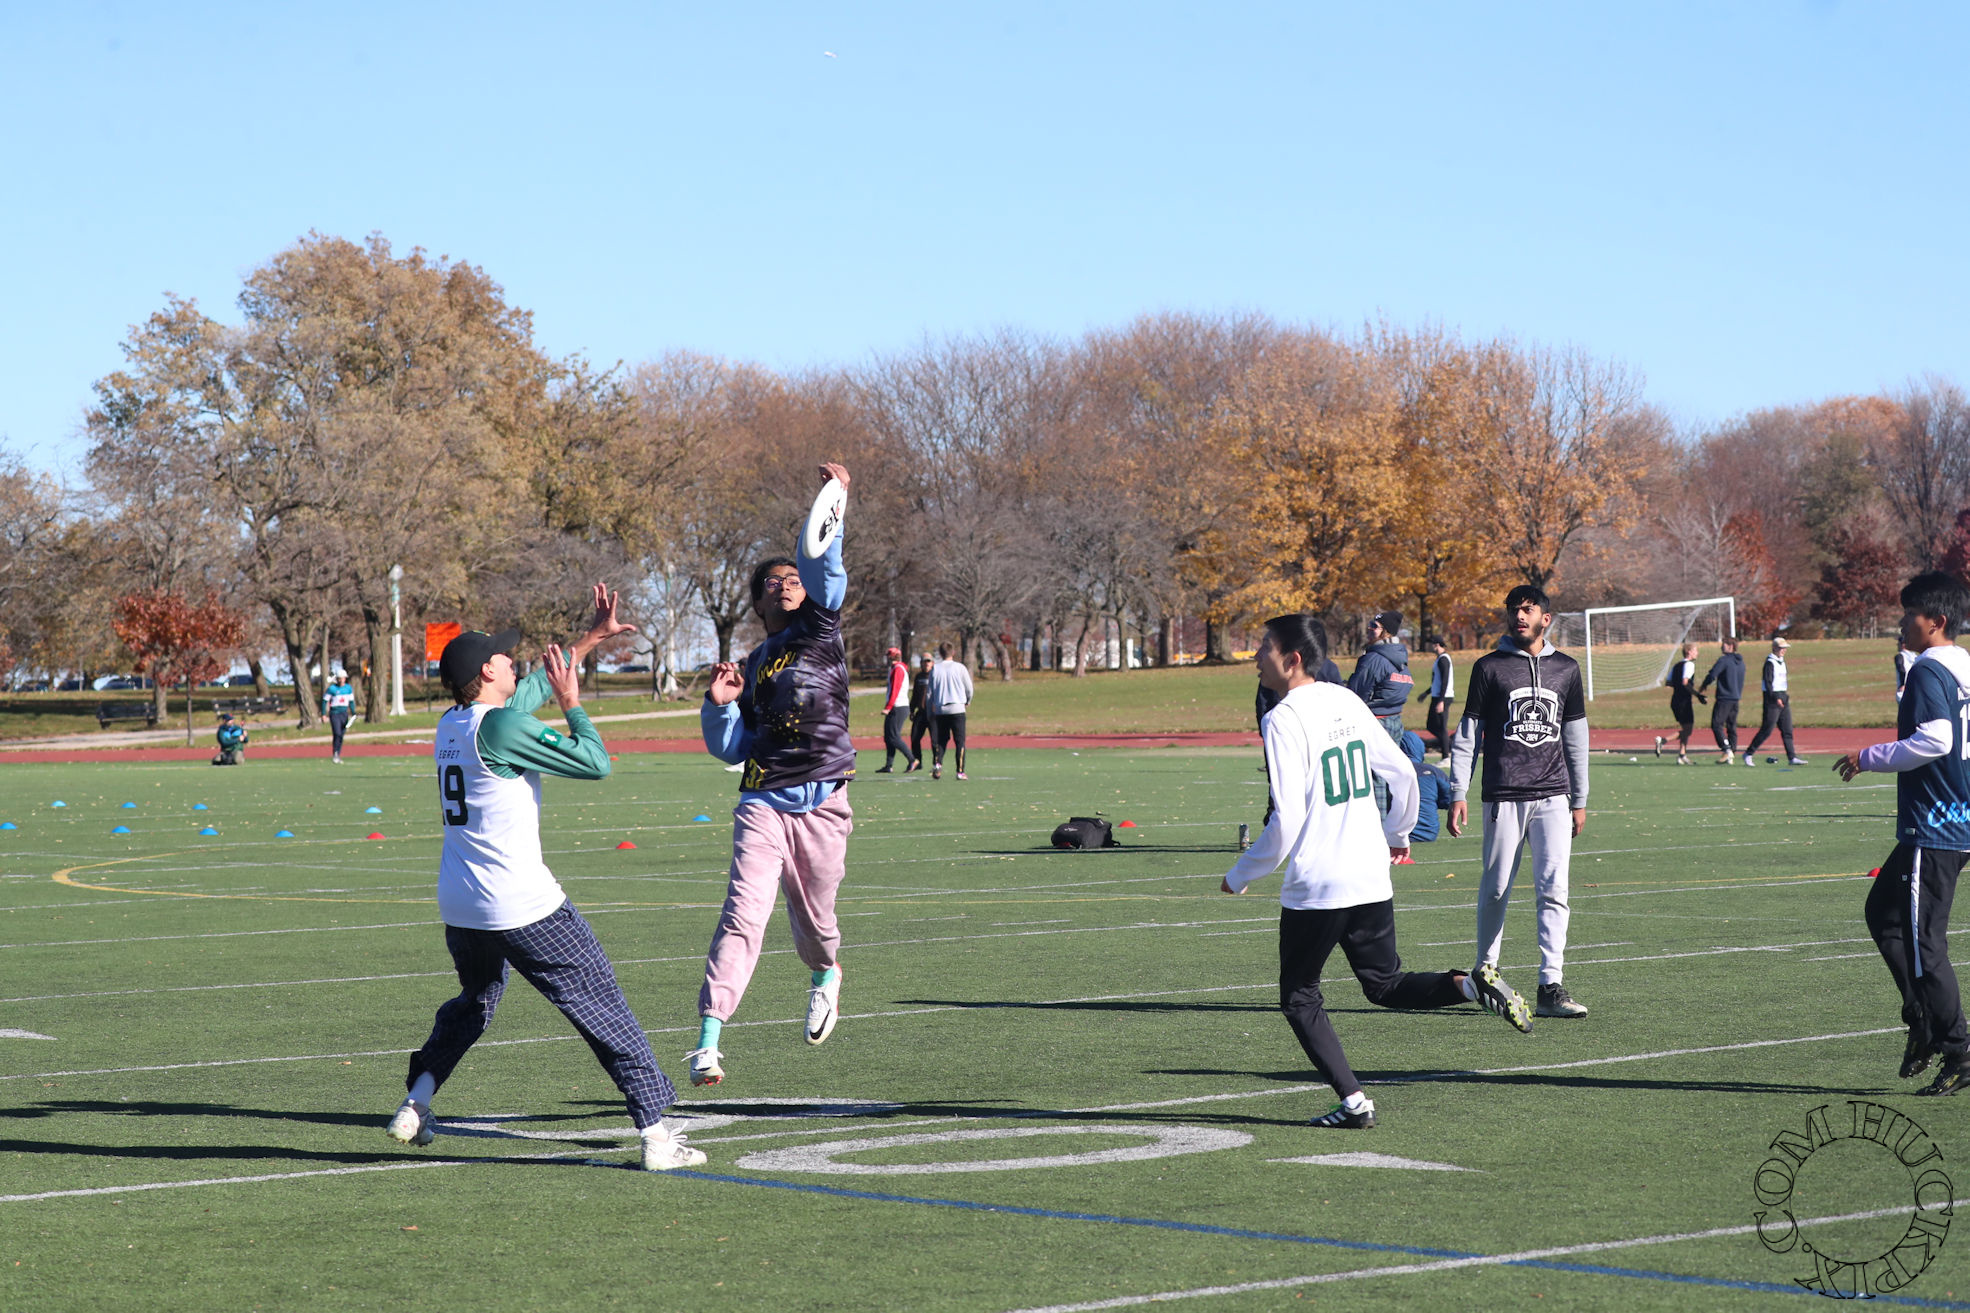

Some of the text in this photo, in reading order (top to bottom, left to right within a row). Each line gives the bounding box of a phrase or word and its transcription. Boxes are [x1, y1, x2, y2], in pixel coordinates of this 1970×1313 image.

[1328, 726, 1356, 742] EGRET
[1512, 724, 1553, 734] FRISBEE
[1525, 733, 1539, 742] 2024
[438, 749, 460, 759] EGRET
[1321, 739, 1371, 807] 00
[437, 764, 469, 826] 19
